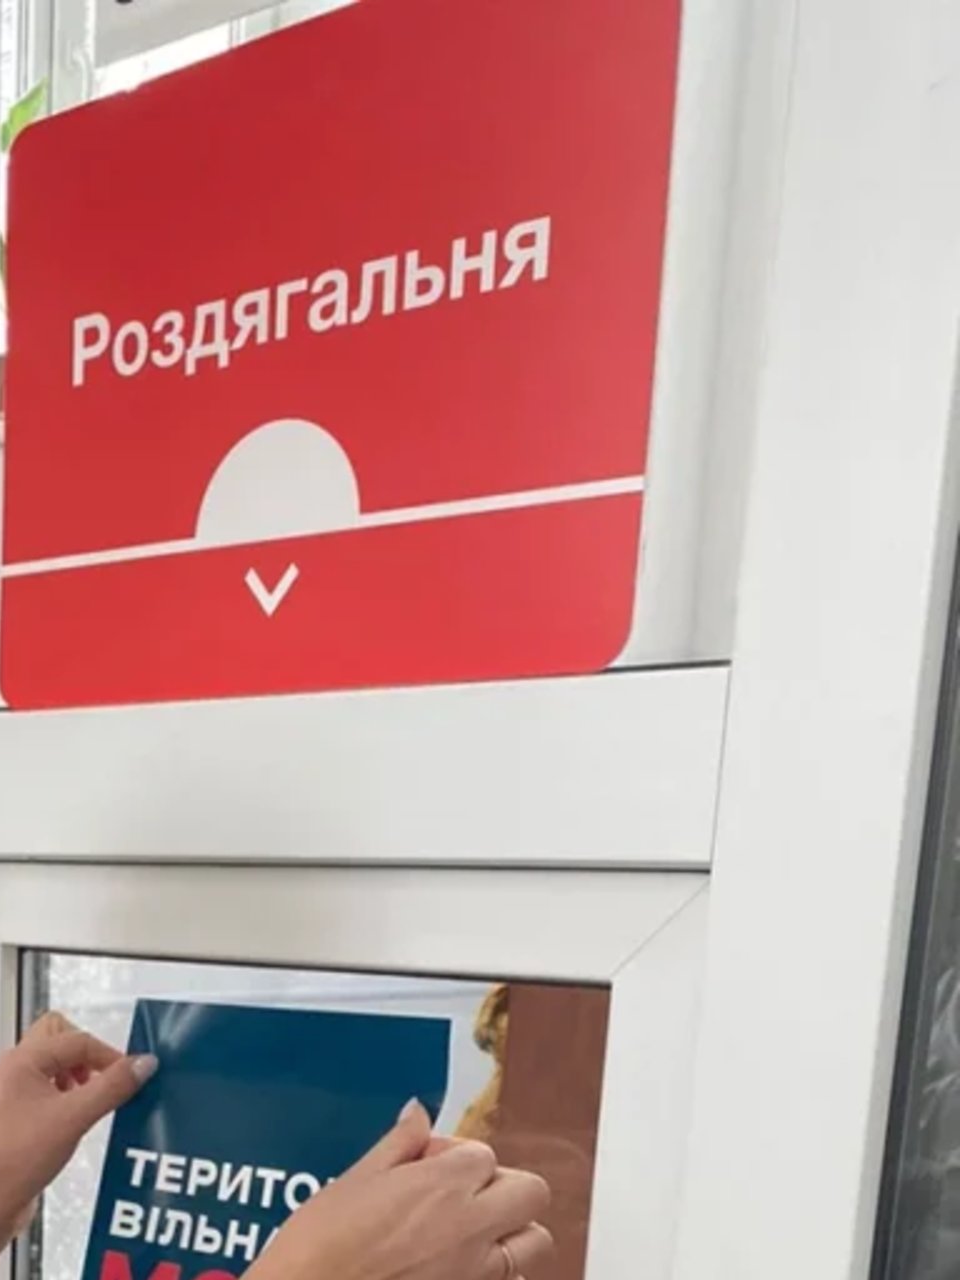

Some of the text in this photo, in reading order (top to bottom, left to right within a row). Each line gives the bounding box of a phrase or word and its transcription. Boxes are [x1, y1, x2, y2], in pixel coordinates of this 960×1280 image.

[71, 215, 552, 388] Роздягальня
[125, 1147, 337, 1212] ТЕРИТО
[109, 1199, 280, 1262] ВІЛЬН
